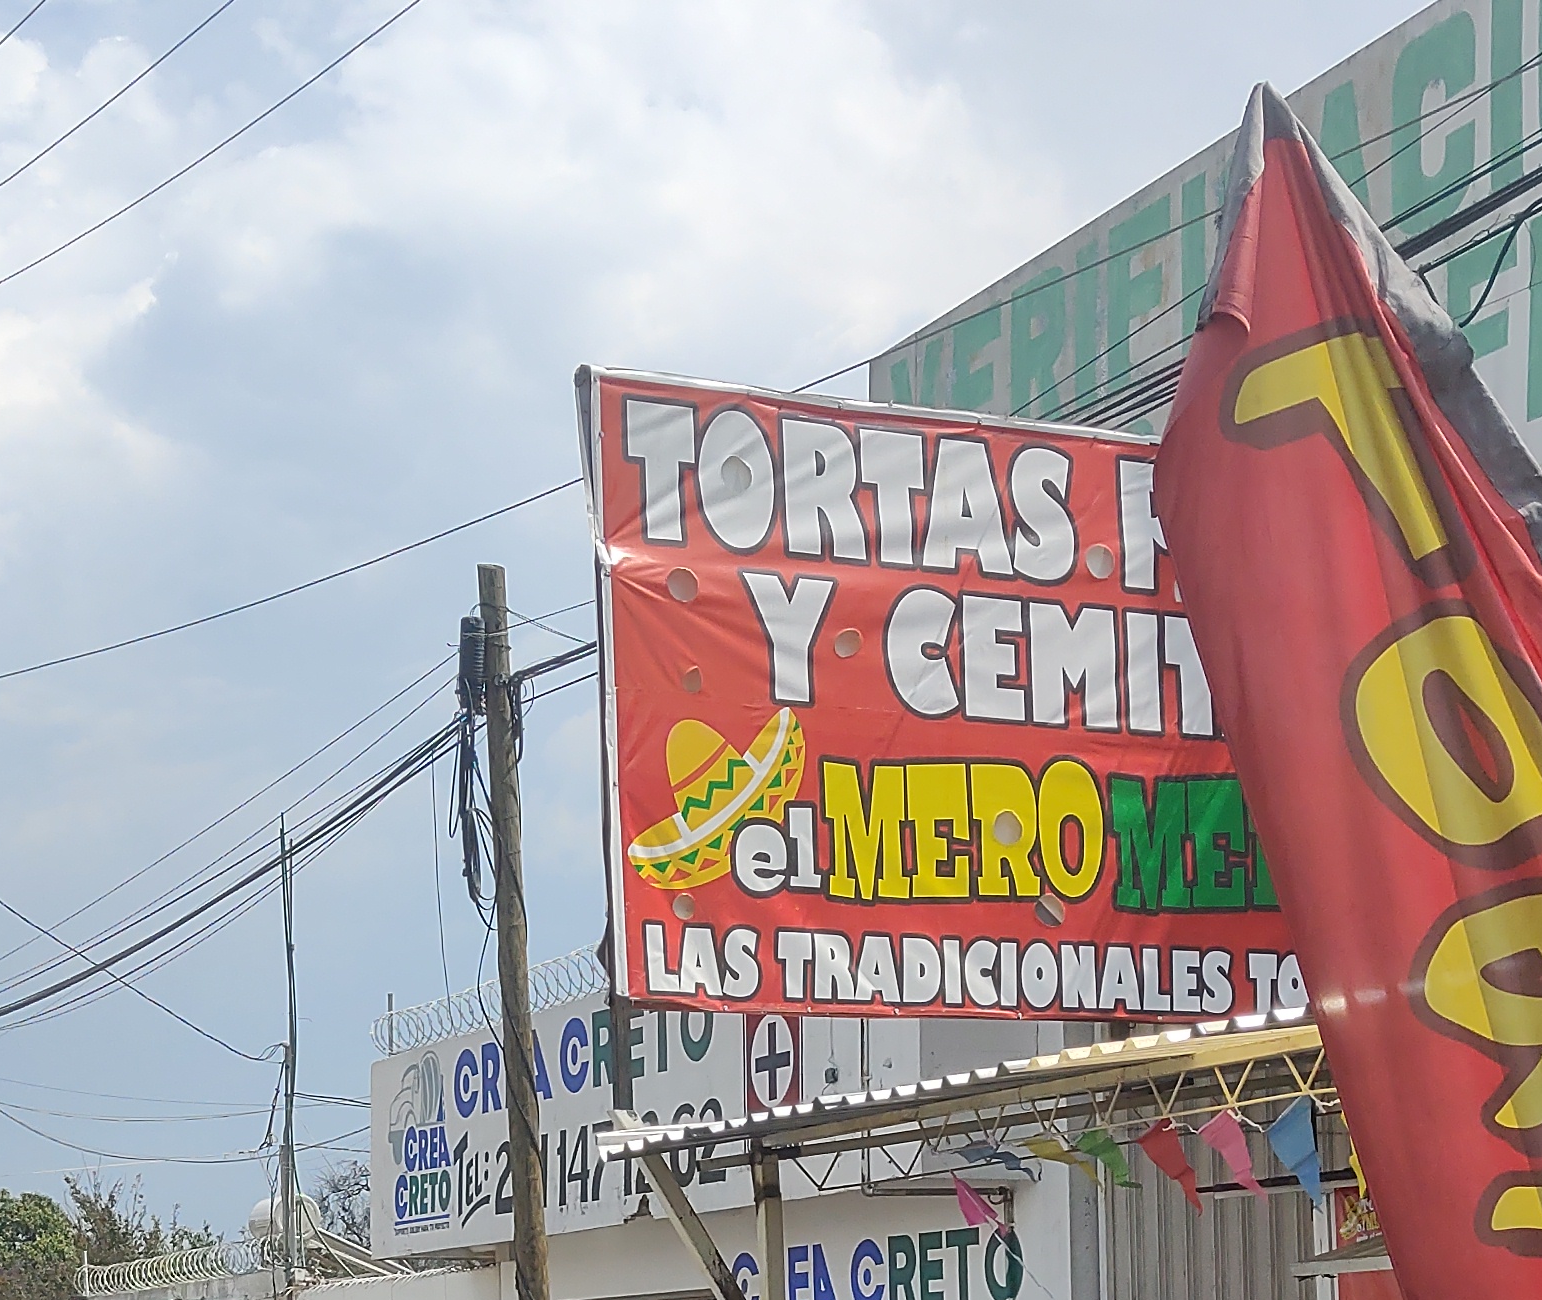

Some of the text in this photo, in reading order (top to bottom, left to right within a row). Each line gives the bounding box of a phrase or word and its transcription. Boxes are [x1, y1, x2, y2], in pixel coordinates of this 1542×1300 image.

[625, 400, 1076, 582] TORTAS
[742, 572, 1213, 736] Y CEMIT
[736, 806, 821, 891] el
[821, 760, 1103, 900] MERO
[645, 924, 760, 998] LAS
[776, 931, 1233, 1013] TRADICIONALES
[454, 1030, 552, 1118] CRA
[405, 1126, 451, 1172] CREA
[395, 1170, 451, 1219] CRETO
